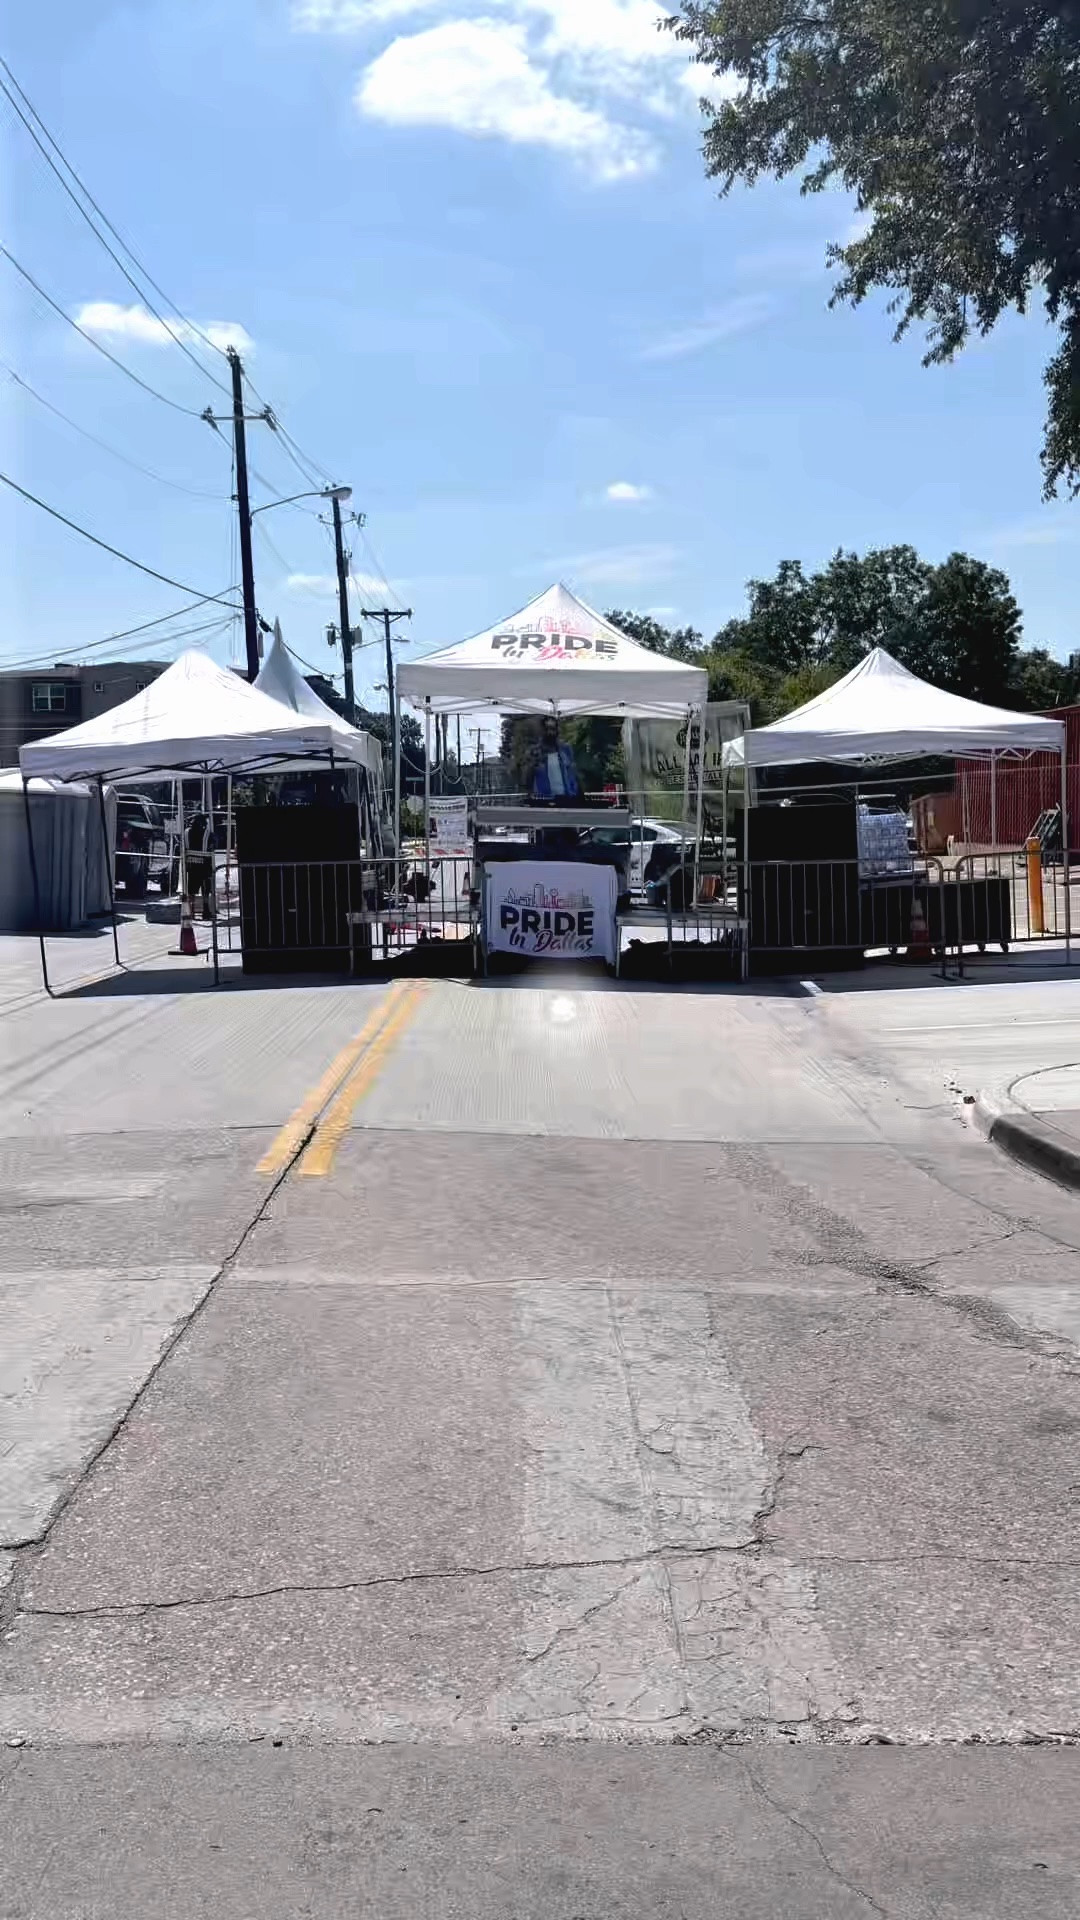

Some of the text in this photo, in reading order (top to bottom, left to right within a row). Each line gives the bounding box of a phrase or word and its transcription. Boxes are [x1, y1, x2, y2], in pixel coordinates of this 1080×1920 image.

[491, 633, 618, 654] PRIDE
[657, 754, 681, 773] ALL
[500, 904, 594, 936] PRIDE
[509, 926, 593, 952] In Dallas
